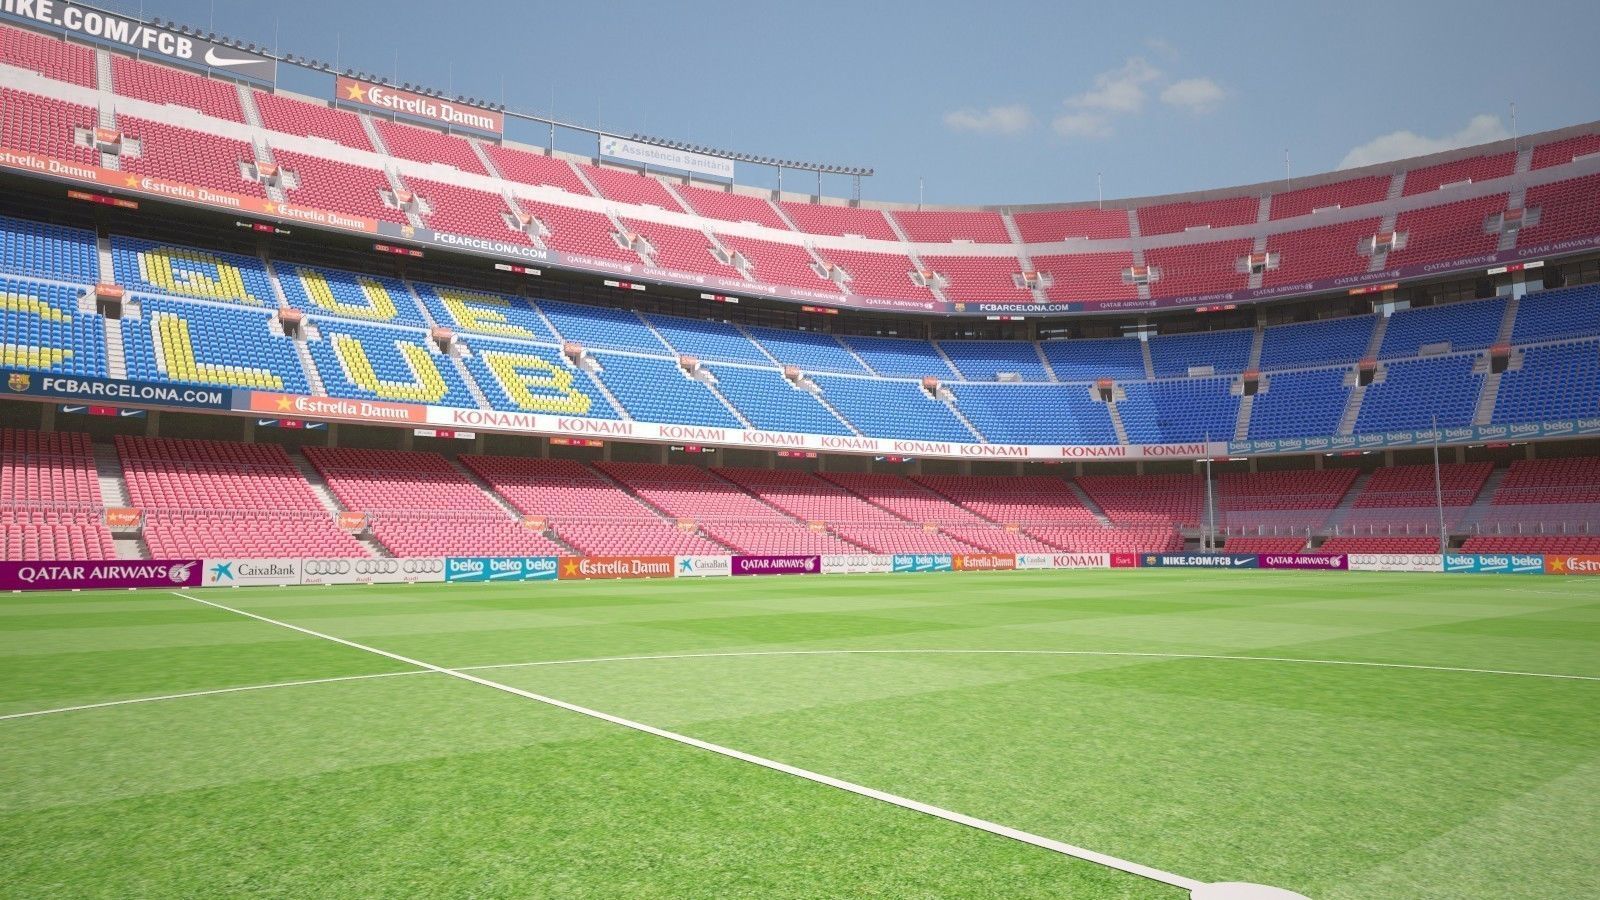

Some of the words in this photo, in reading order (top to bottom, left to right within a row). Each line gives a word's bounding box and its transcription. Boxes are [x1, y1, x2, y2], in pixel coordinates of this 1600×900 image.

[0, 0, 193, 59] IKE.COM/FCB
[368, 86, 437, 117] Estrella
[440, 103, 494, 130] Damm
[48, 159, 96, 179] Damm
[141, 178, 194, 198] Estrella
[197, 189, 240, 206] Damm
[278, 203, 325, 223] Estrella
[328, 214, 364, 230] Damm
[434, 232, 547, 259] FCBARCELONA.COM
[1518, 246, 1549, 256] QATAR
[1551, 238, 1593, 250] AIRWAYS
[568, 256, 592, 265] QATAR
[594, 260, 624, 270] AIRWAYS
[1424, 262, 1451, 272] QATAR
[1453, 256, 1486, 267] AIRWAYS
[643, 268, 666, 277] QATAR
[668, 272, 696, 281] AIRWAYS
[1334, 276, 1359, 285] QATAR
[1360, 272, 1391, 281] AIRWAYS
[719, 279, 740, 288] QATAR
[741, 282, 768, 292] AIRWAYS
[1253, 288, 1275, 296] QATAR
[1276, 284, 1304, 294] AIRWAYS
[791, 289, 812, 298] QATAR
[814, 292, 839, 300] AIRWAYS
[1176, 296, 1196, 304] QATAR
[1198, 292, 1225, 301] AIRWAYS
[866, 298, 891, 306] QATAR
[893, 300, 925, 308] AIRWAYS
[980, 304, 1069, 312] FCBARCELONA.COM
[1122, 300, 1149, 308] AIRWAYS
[43, 378, 222, 404] FCBARCELONA.COM
[295, 396, 357, 415] Estrella
[360, 402, 408, 419] Damm
[453, 410, 536, 428] KONAMI
[558, 418, 632, 434] KONAMI
[1478, 426, 1507, 435] beko
[1510, 424, 1539, 432] beko
[1543, 421, 1574, 430] beko
[659, 426, 726, 440] KONAMI
[1359, 434, 1383, 442] beko
[1387, 432, 1412, 440] beko
[1446, 428, 1472, 437] beko
[742, 432, 804, 446] KONAMI
[822, 436, 878, 450] KONAMI
[1254, 440, 1276, 448] beko
[1280, 439, 1302, 448] beko
[1305, 438, 1328, 446] beko
[1332, 436, 1355, 444] beko
[894, 441, 951, 454] KONAMI
[960, 445, 1028, 456] KONAMI
[1062, 446, 1126, 456] KONAMI
[1143, 444, 1205, 456] KONAMI
[1230, 442, 1251, 450] beko
[450, 558, 484, 572] beko
[490, 558, 522, 571] beko
[526, 558, 556, 570] beko
[694, 558, 728, 569] CaixaBank
[740, 560, 768, 570] QATAR
[770, 559, 804, 568] AIRWAYS
[895, 556, 914, 565] beko
[916, 556, 932, 565] beko
[934, 556, 950, 564] beko
[964, 556, 991, 567] Estrella
[992, 556, 1014, 568] Damm
[1054, 556, 1104, 566] KONAMI
[1163, 556, 1231, 566] NIKE.COM/FCB
[1266, 556, 1293, 566] QATAR
[1294, 556, 1330, 565] AIRWAYS
[1446, 556, 1474, 565] beko
[1480, 556, 1508, 566] beko
[1512, 556, 1542, 566] beko
[238, 563, 295, 576] CaixaBank
[579, 559, 629, 574] Estrella
[631, 560, 670, 574] Damm
[18, 566, 85, 582] QATAR
[90, 566, 167, 580] AIRWAYS
